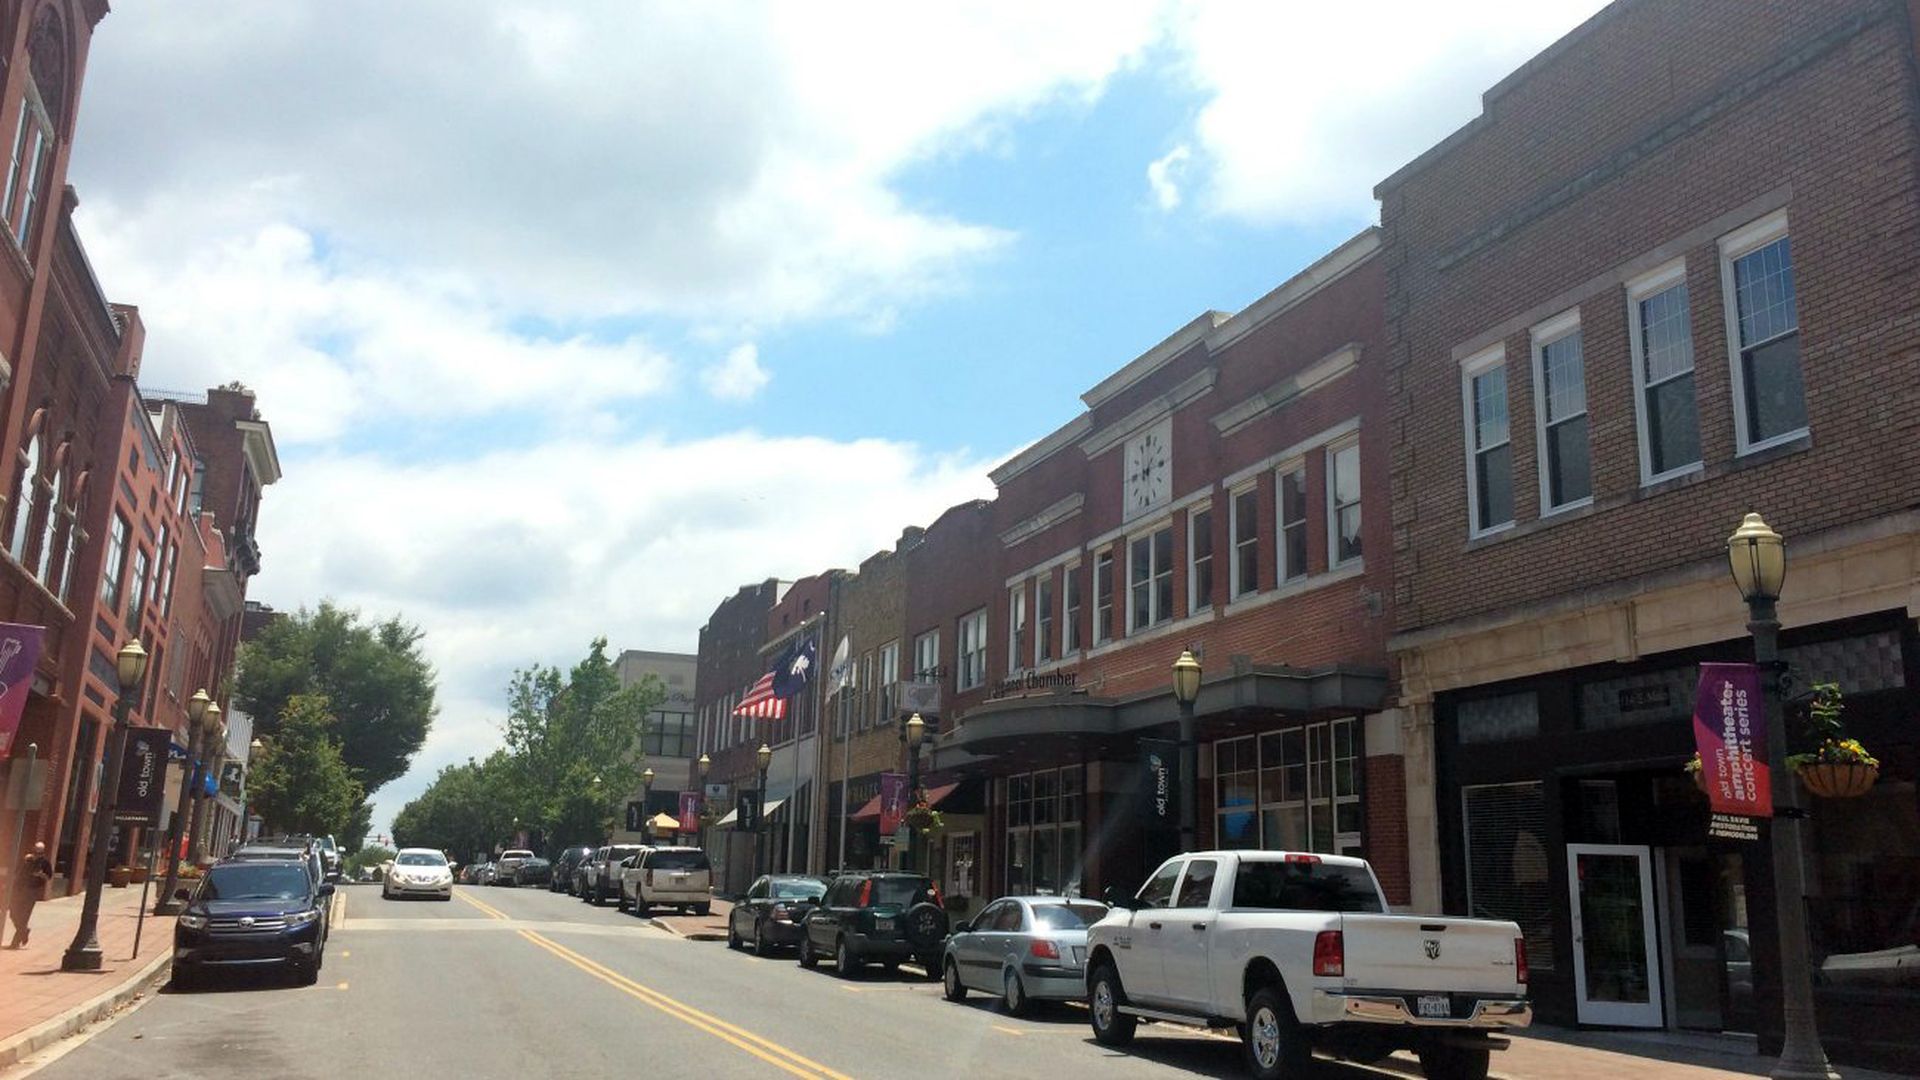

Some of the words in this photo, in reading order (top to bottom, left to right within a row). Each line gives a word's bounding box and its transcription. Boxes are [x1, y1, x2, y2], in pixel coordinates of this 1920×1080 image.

[1027, 667, 1078, 690] Chamber
[1735, 689, 1750, 735] series
[1720, 680, 1745, 801] amphitheater
[140, 752, 153, 778] town
[1715, 748, 1728, 777] town
[1740, 739, 1757, 802] concert
[137, 781, 148, 797] old
[1157, 768, 1165, 795] town
[1719, 781, 1732, 799] old
[1156, 797, 1166, 816] old
